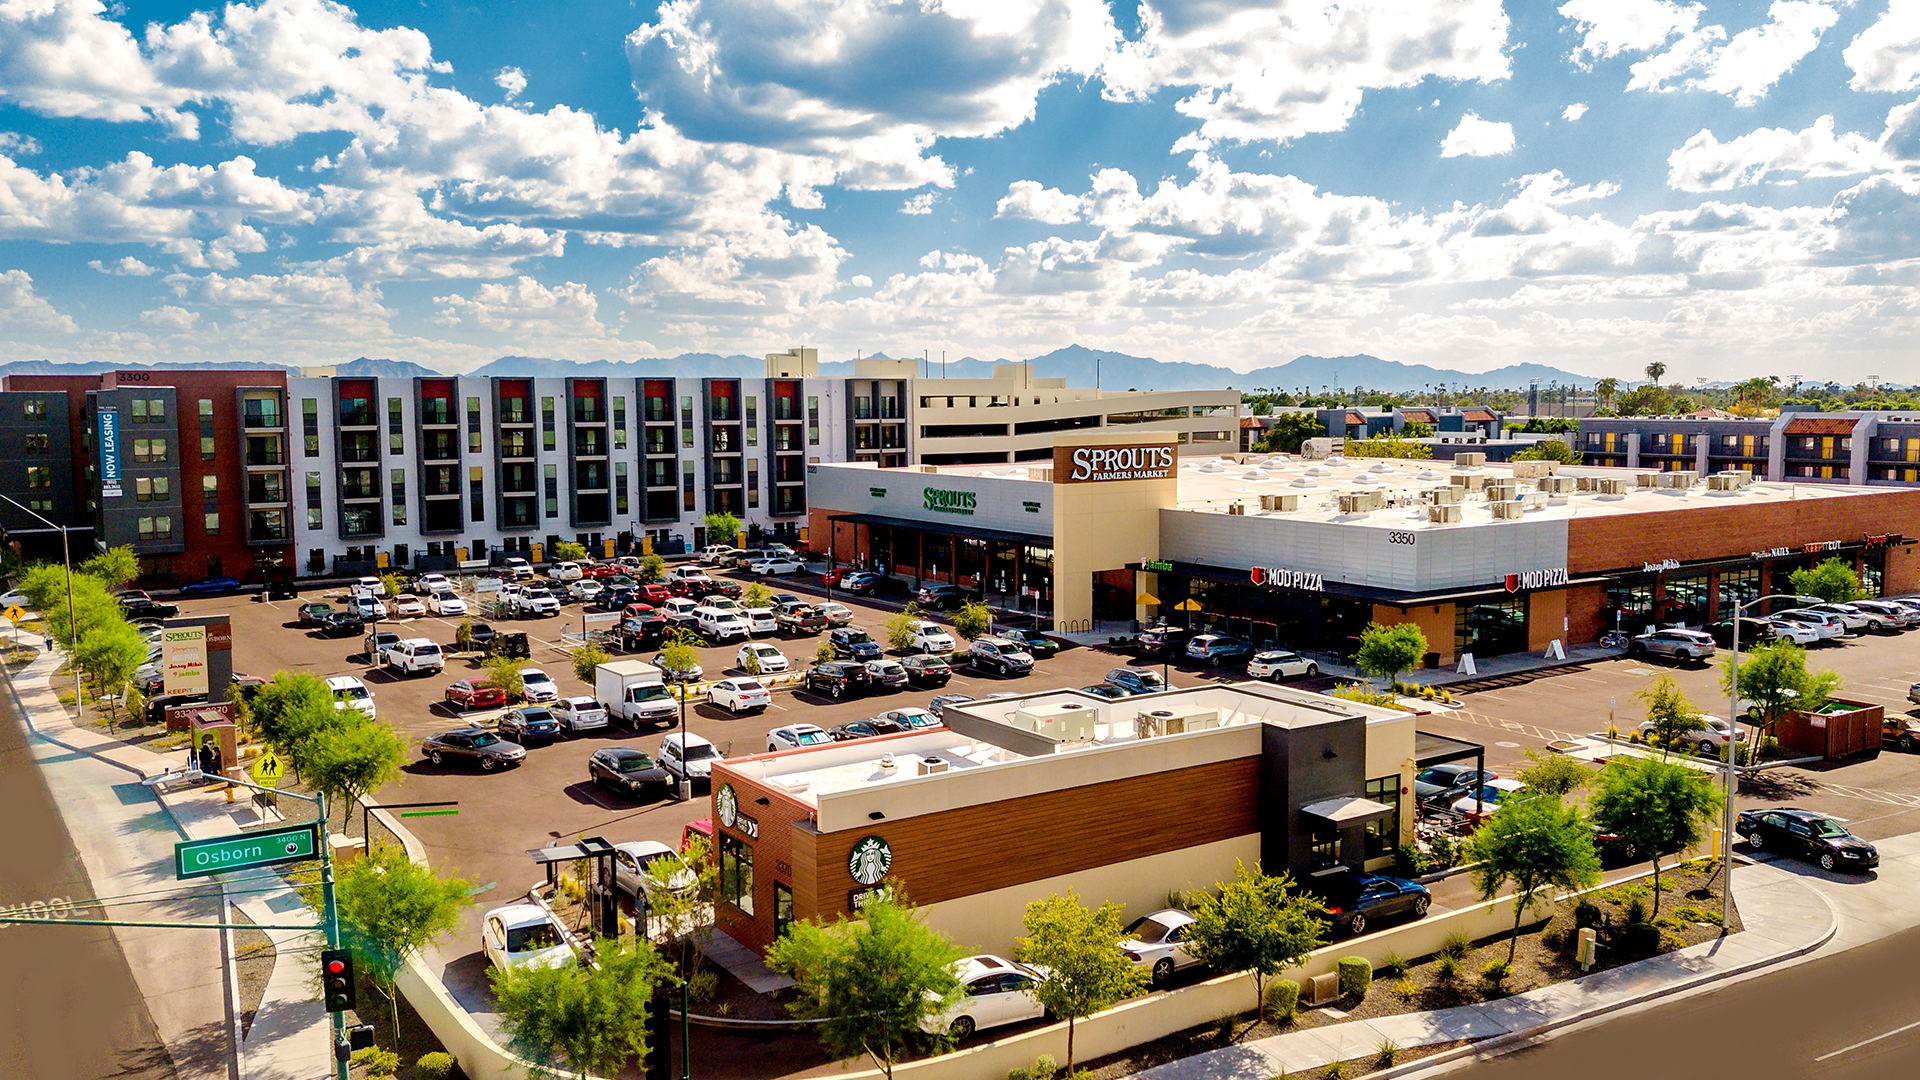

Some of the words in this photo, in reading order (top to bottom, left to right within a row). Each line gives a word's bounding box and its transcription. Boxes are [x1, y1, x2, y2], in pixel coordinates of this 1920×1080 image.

[119, 372, 150, 382] 3300
[103, 413, 115, 452] LEASING
[106, 454, 116, 478] NOW
[1071, 446, 1173, 480] SPROUTS
[1093, 471, 1132, 481] FARMERS
[1133, 469, 1169, 479] MARKET
[922, 486, 977, 511] SPROUTS
[1389, 531, 1415, 546] 3350
[1771, 547, 1789, 558] NAILS
[1268, 568, 1292, 588] MOD
[1293, 571, 1323, 592] PIZZA
[1522, 571, 1543, 590] MOD
[1543, 567, 1569, 586] PIZZA
[165, 630, 204, 642] SPROUTS
[179, 670, 200, 678] jamba
[276, 835, 298, 844] 3400
[196, 845, 262, 865] Osborn
